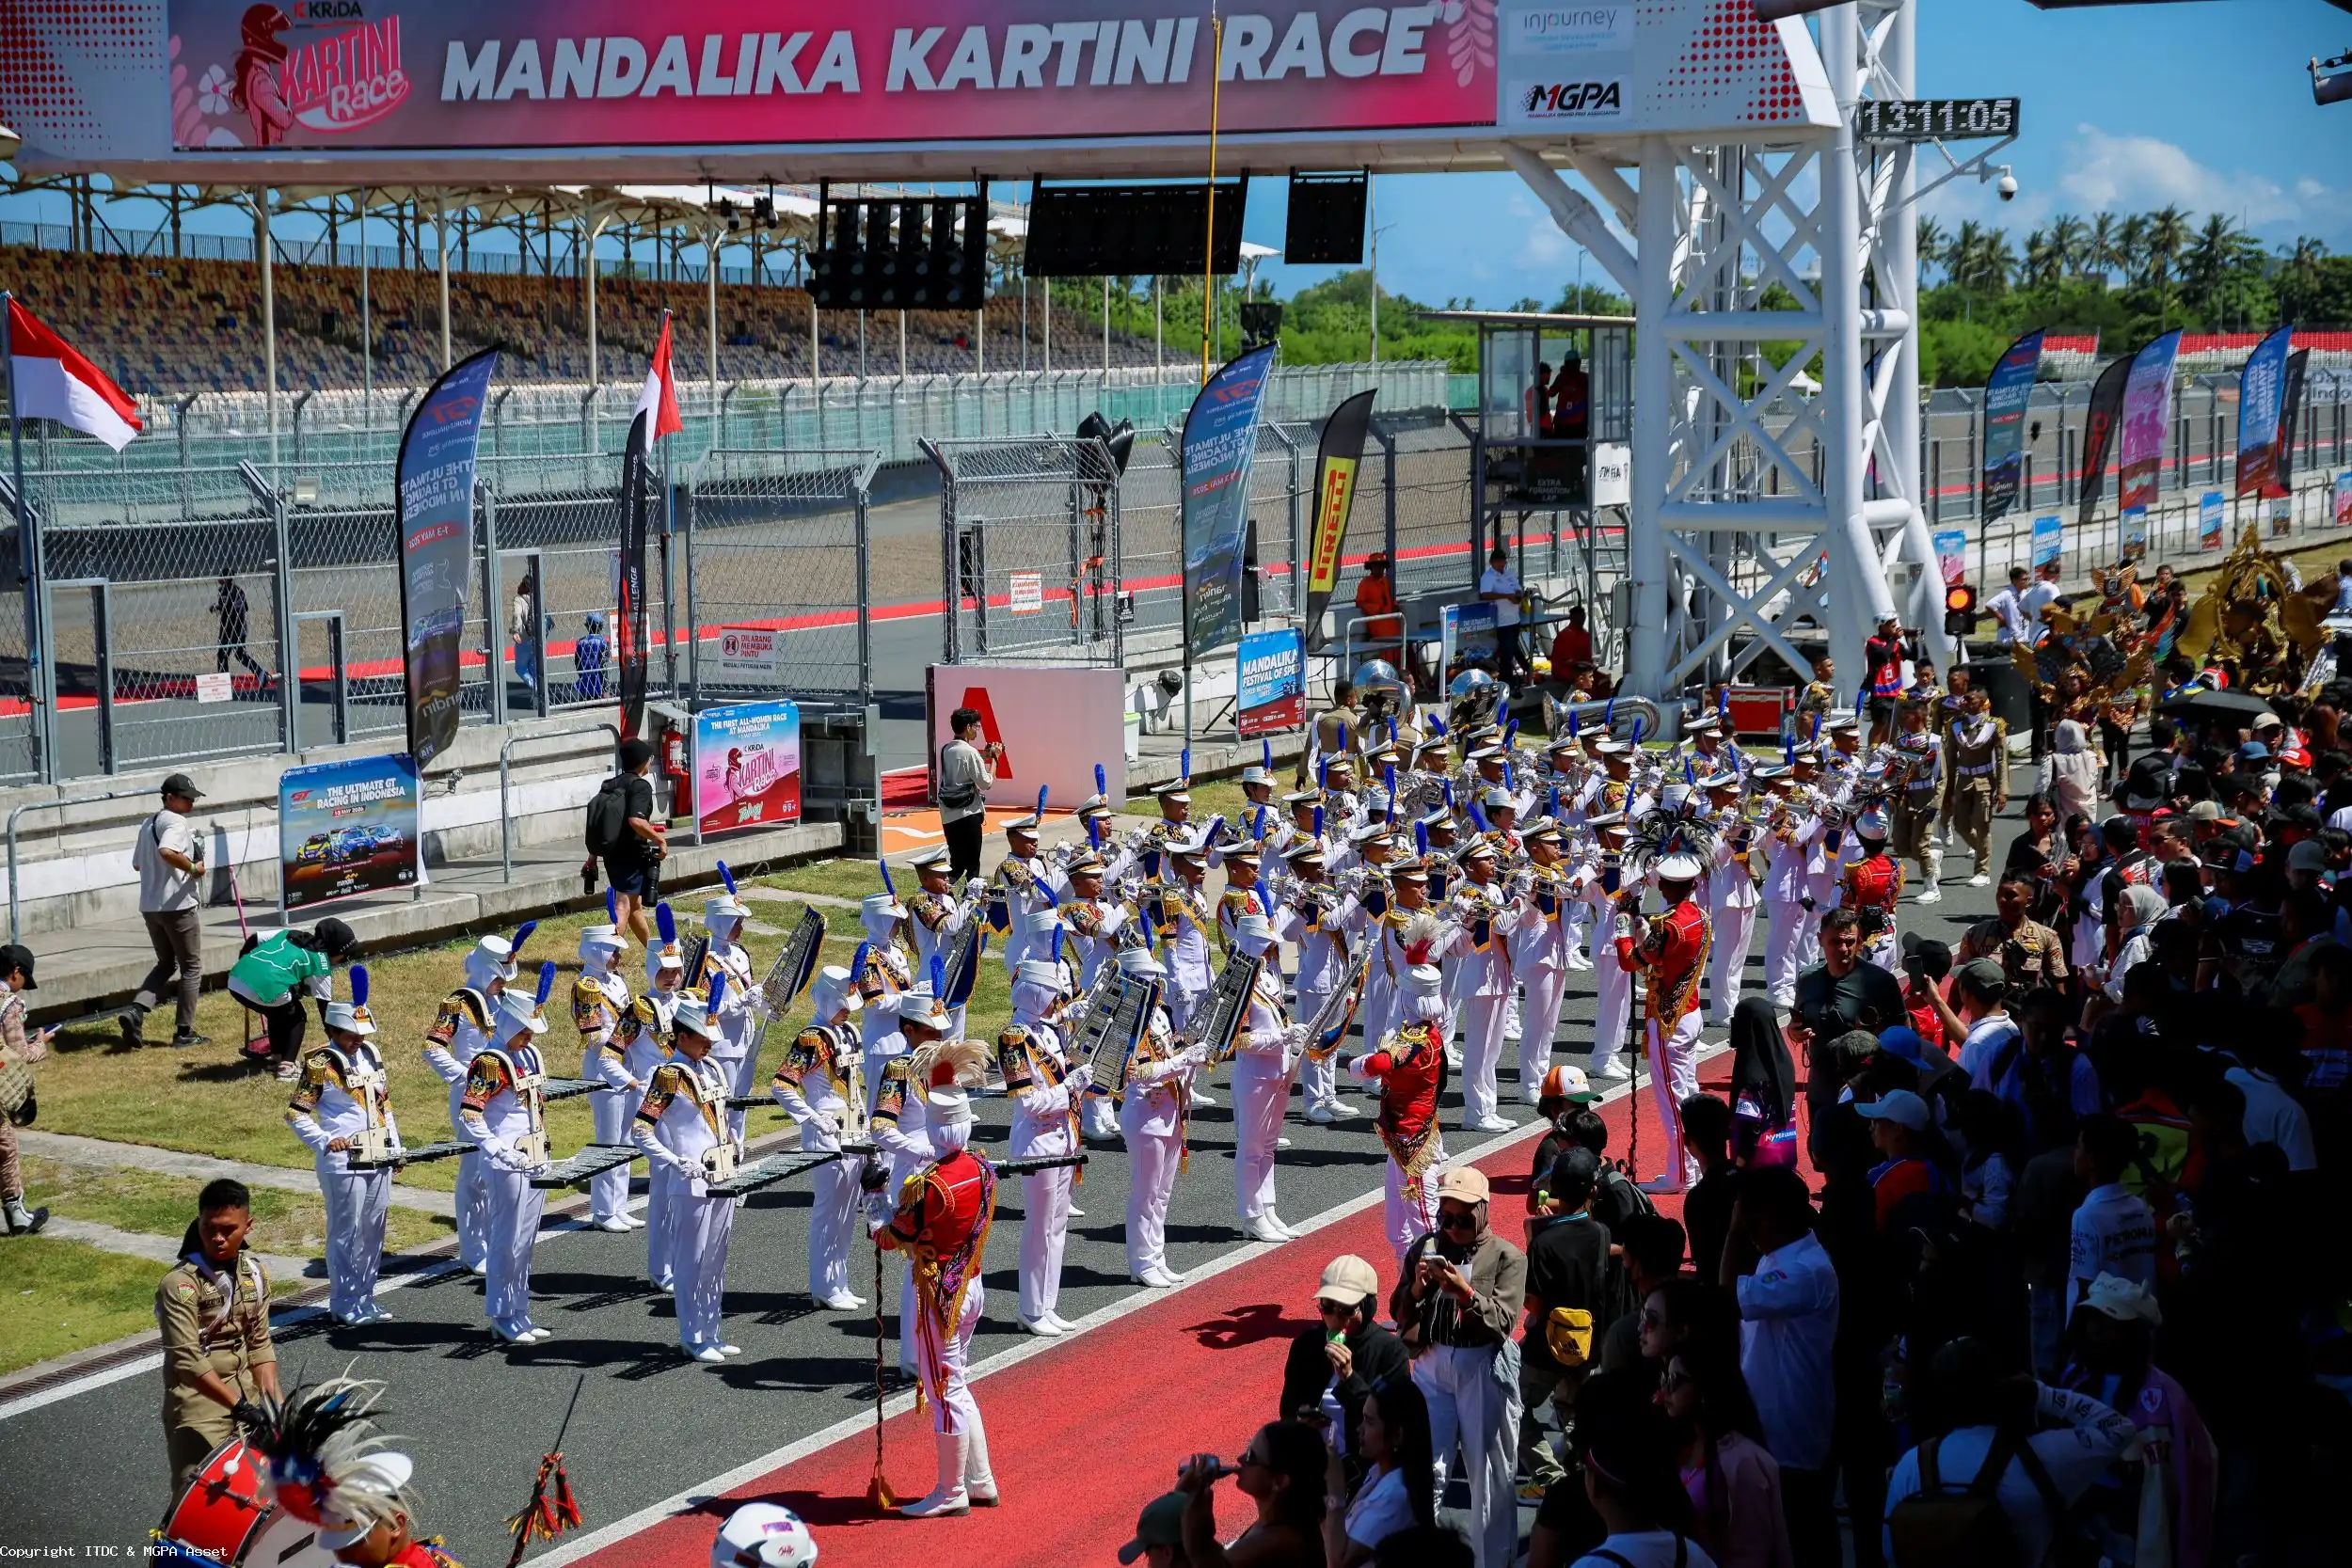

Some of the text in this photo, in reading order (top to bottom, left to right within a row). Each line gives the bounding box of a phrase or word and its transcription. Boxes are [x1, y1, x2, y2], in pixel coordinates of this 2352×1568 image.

[1524, 8, 1617, 33] injourney
[279, 14, 402, 111] KARTINI
[440, 6, 1439, 102] MANDALIKA KARTINI RACE
[331, 69, 405, 120] Race
[1526, 81, 1621, 111] MGPA
[1865, 100, 2012, 133] 13:11:05
[1315, 468, 1347, 580] PIRELLI
[740, 635, 772, 643] DILARANG
[740, 642, 773, 651] MEMBUKA
[1242, 648, 1298, 677] MANDALIKA
[1243, 671, 1273, 689] FESTIVAL
[1274, 668, 1282, 681] OF
[711, 712, 787, 730] THE FIRST ALL-WOMEN RACE
[728, 726, 738, 736] AT
[739, 748, 775, 787] KARTINI
[753, 768, 777, 792] Race
[316, 786, 406, 811] RACING IN INDONESIA
[327, 777, 397, 797] THE ULTIMATE GT
